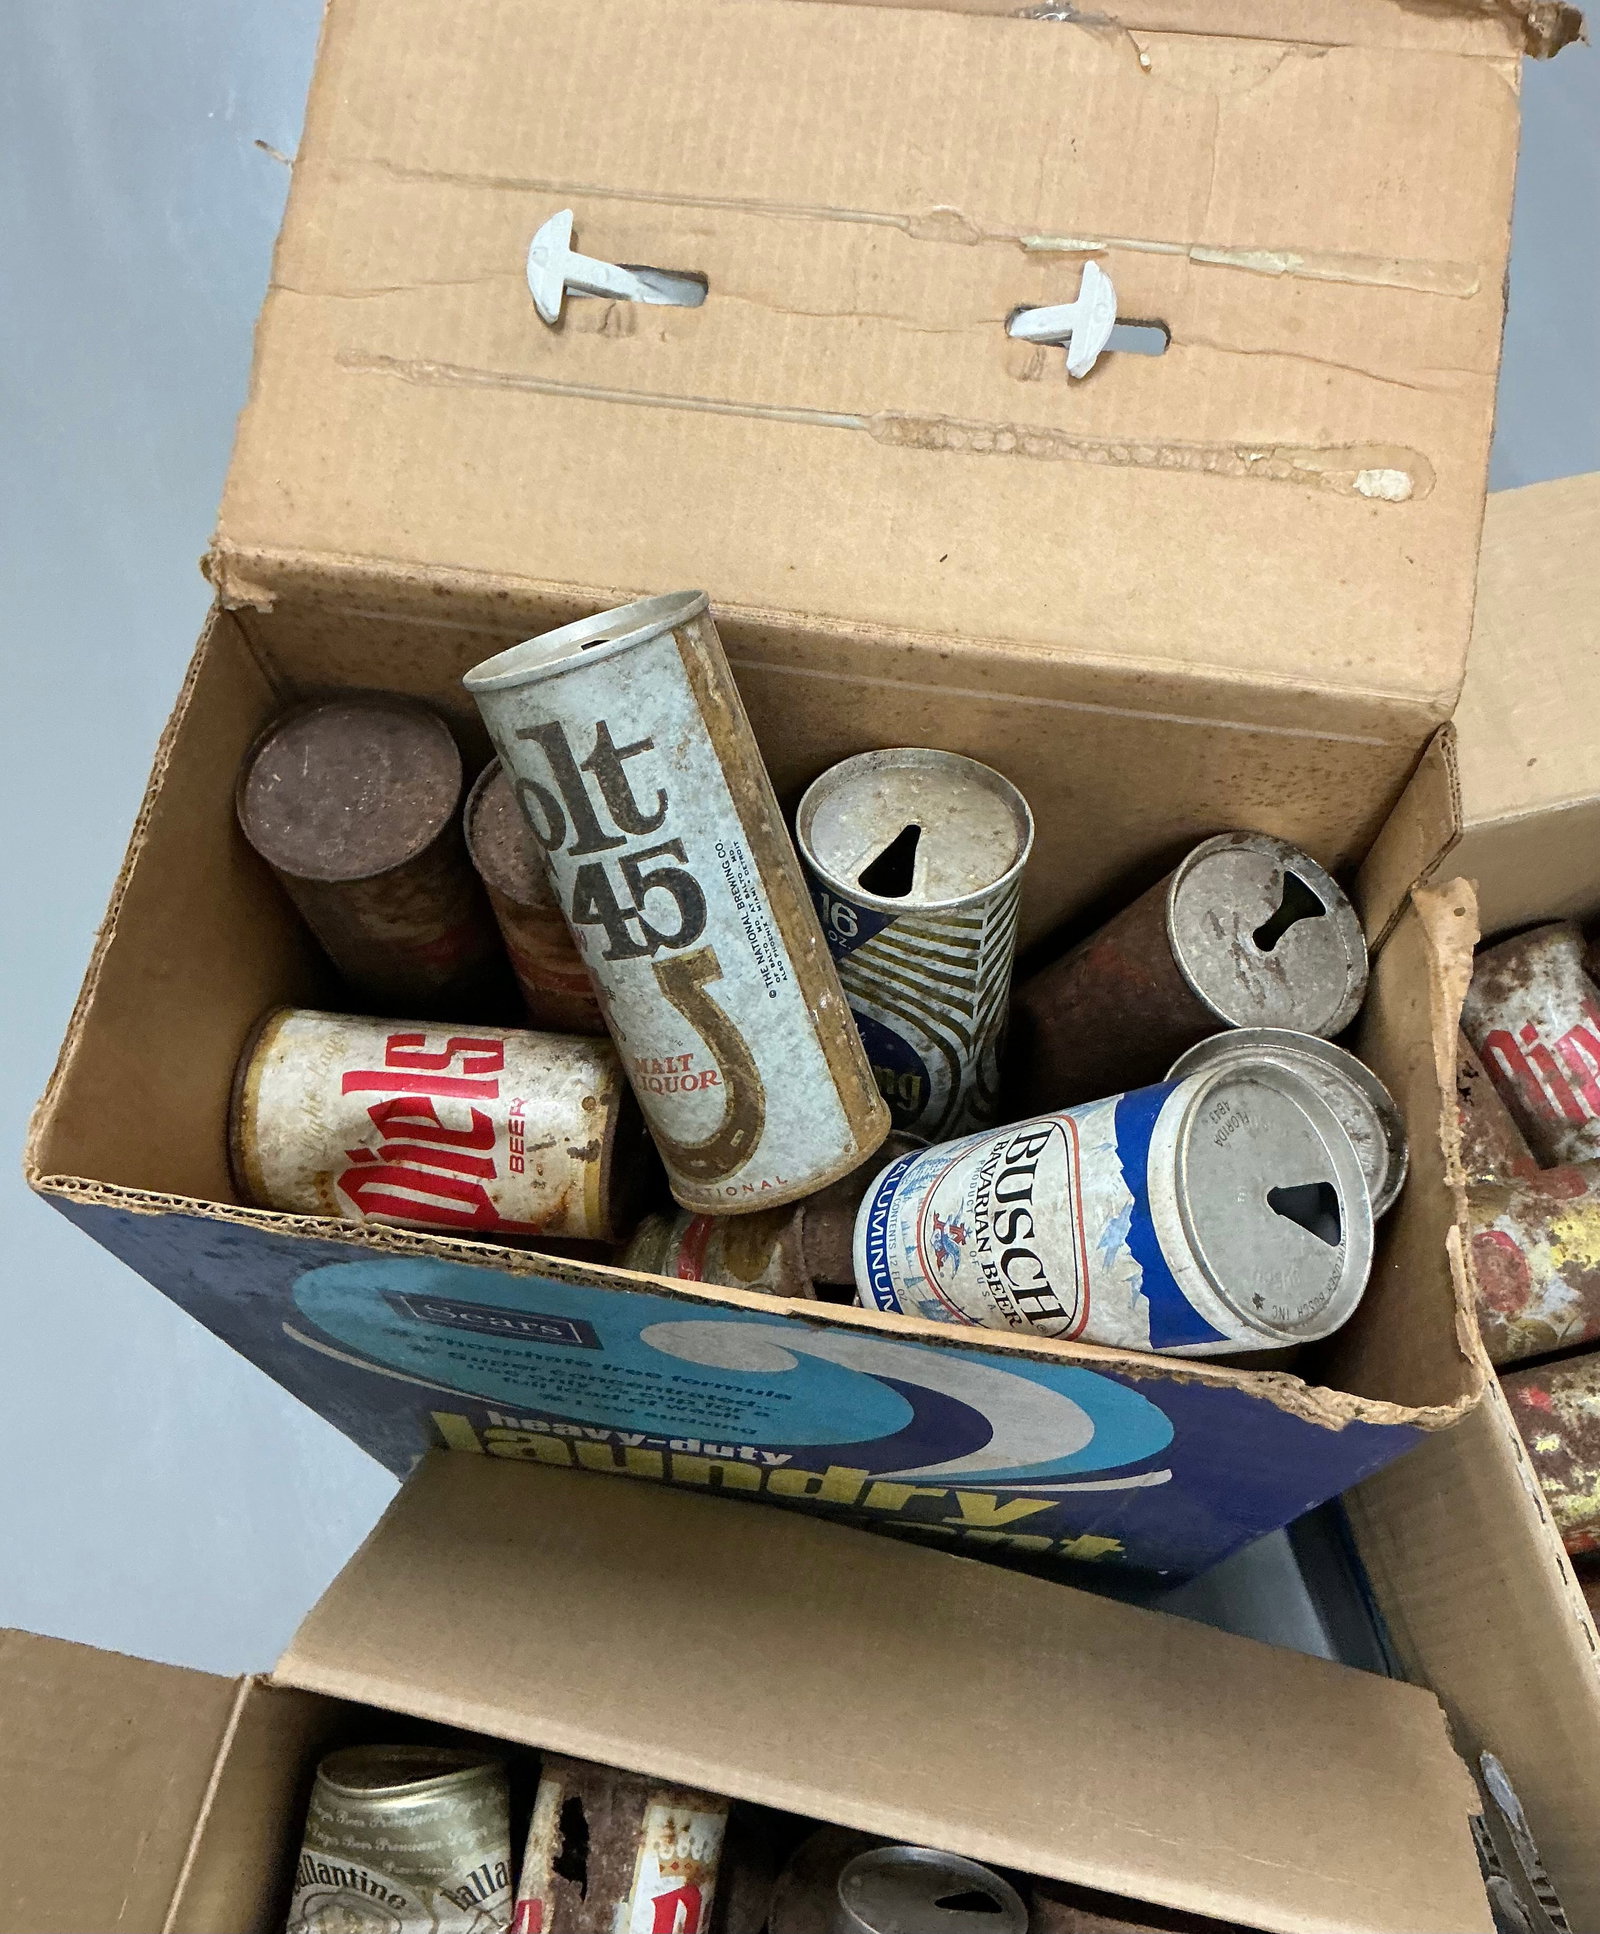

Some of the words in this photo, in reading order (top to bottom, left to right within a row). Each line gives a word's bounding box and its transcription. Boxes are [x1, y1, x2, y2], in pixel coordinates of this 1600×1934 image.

[506, 718, 668, 856] olt
[714, 839, 727, 860] CO.
[733, 840, 750, 876] DETROIT
[571, 837, 708, 961] 45
[721, 861, 746, 911] BREWING
[750, 886, 763, 912] MIAMI
[748, 902, 756, 914] AT
[820, 892, 859, 938] 16
[740, 912, 766, 966] NATIONAL
[762, 921, 780, 959] PHOENIX
[760, 967, 774, 989] THE
[773, 972, 782, 983] OF
[777, 960, 788, 982] ALSO
[633, 1069, 722, 1097] LIQUOR
[634, 1052, 694, 1076] MALT
[509, 1096, 530, 1175] BEER
[1213, 1110, 1250, 1148] FLORIDA
[966, 1159, 986, 1214] PRODUCT
[973, 1139, 1011, 1254] BAVARIAN
[886, 1197, 900, 1250] CONTENTS
[993, 1123, 1073, 1326] BUSCH
[889, 1255, 898, 1267] 12
[969, 1250, 980, 1267] OF
[981, 1261, 1024, 1328] BEER
[422, 1303, 563, 1337] Sears
[602, 1362, 663, 1380] free
[671, 1374, 792, 1401] formula
[665, 1403, 741, 1421] wash
[705, 1401, 747, 1413] for
[486, 1410, 794, 1467] heavy-duty
[429, 1410, 1061, 1527] laundry
[293, 1853, 407, 1911] allantine
